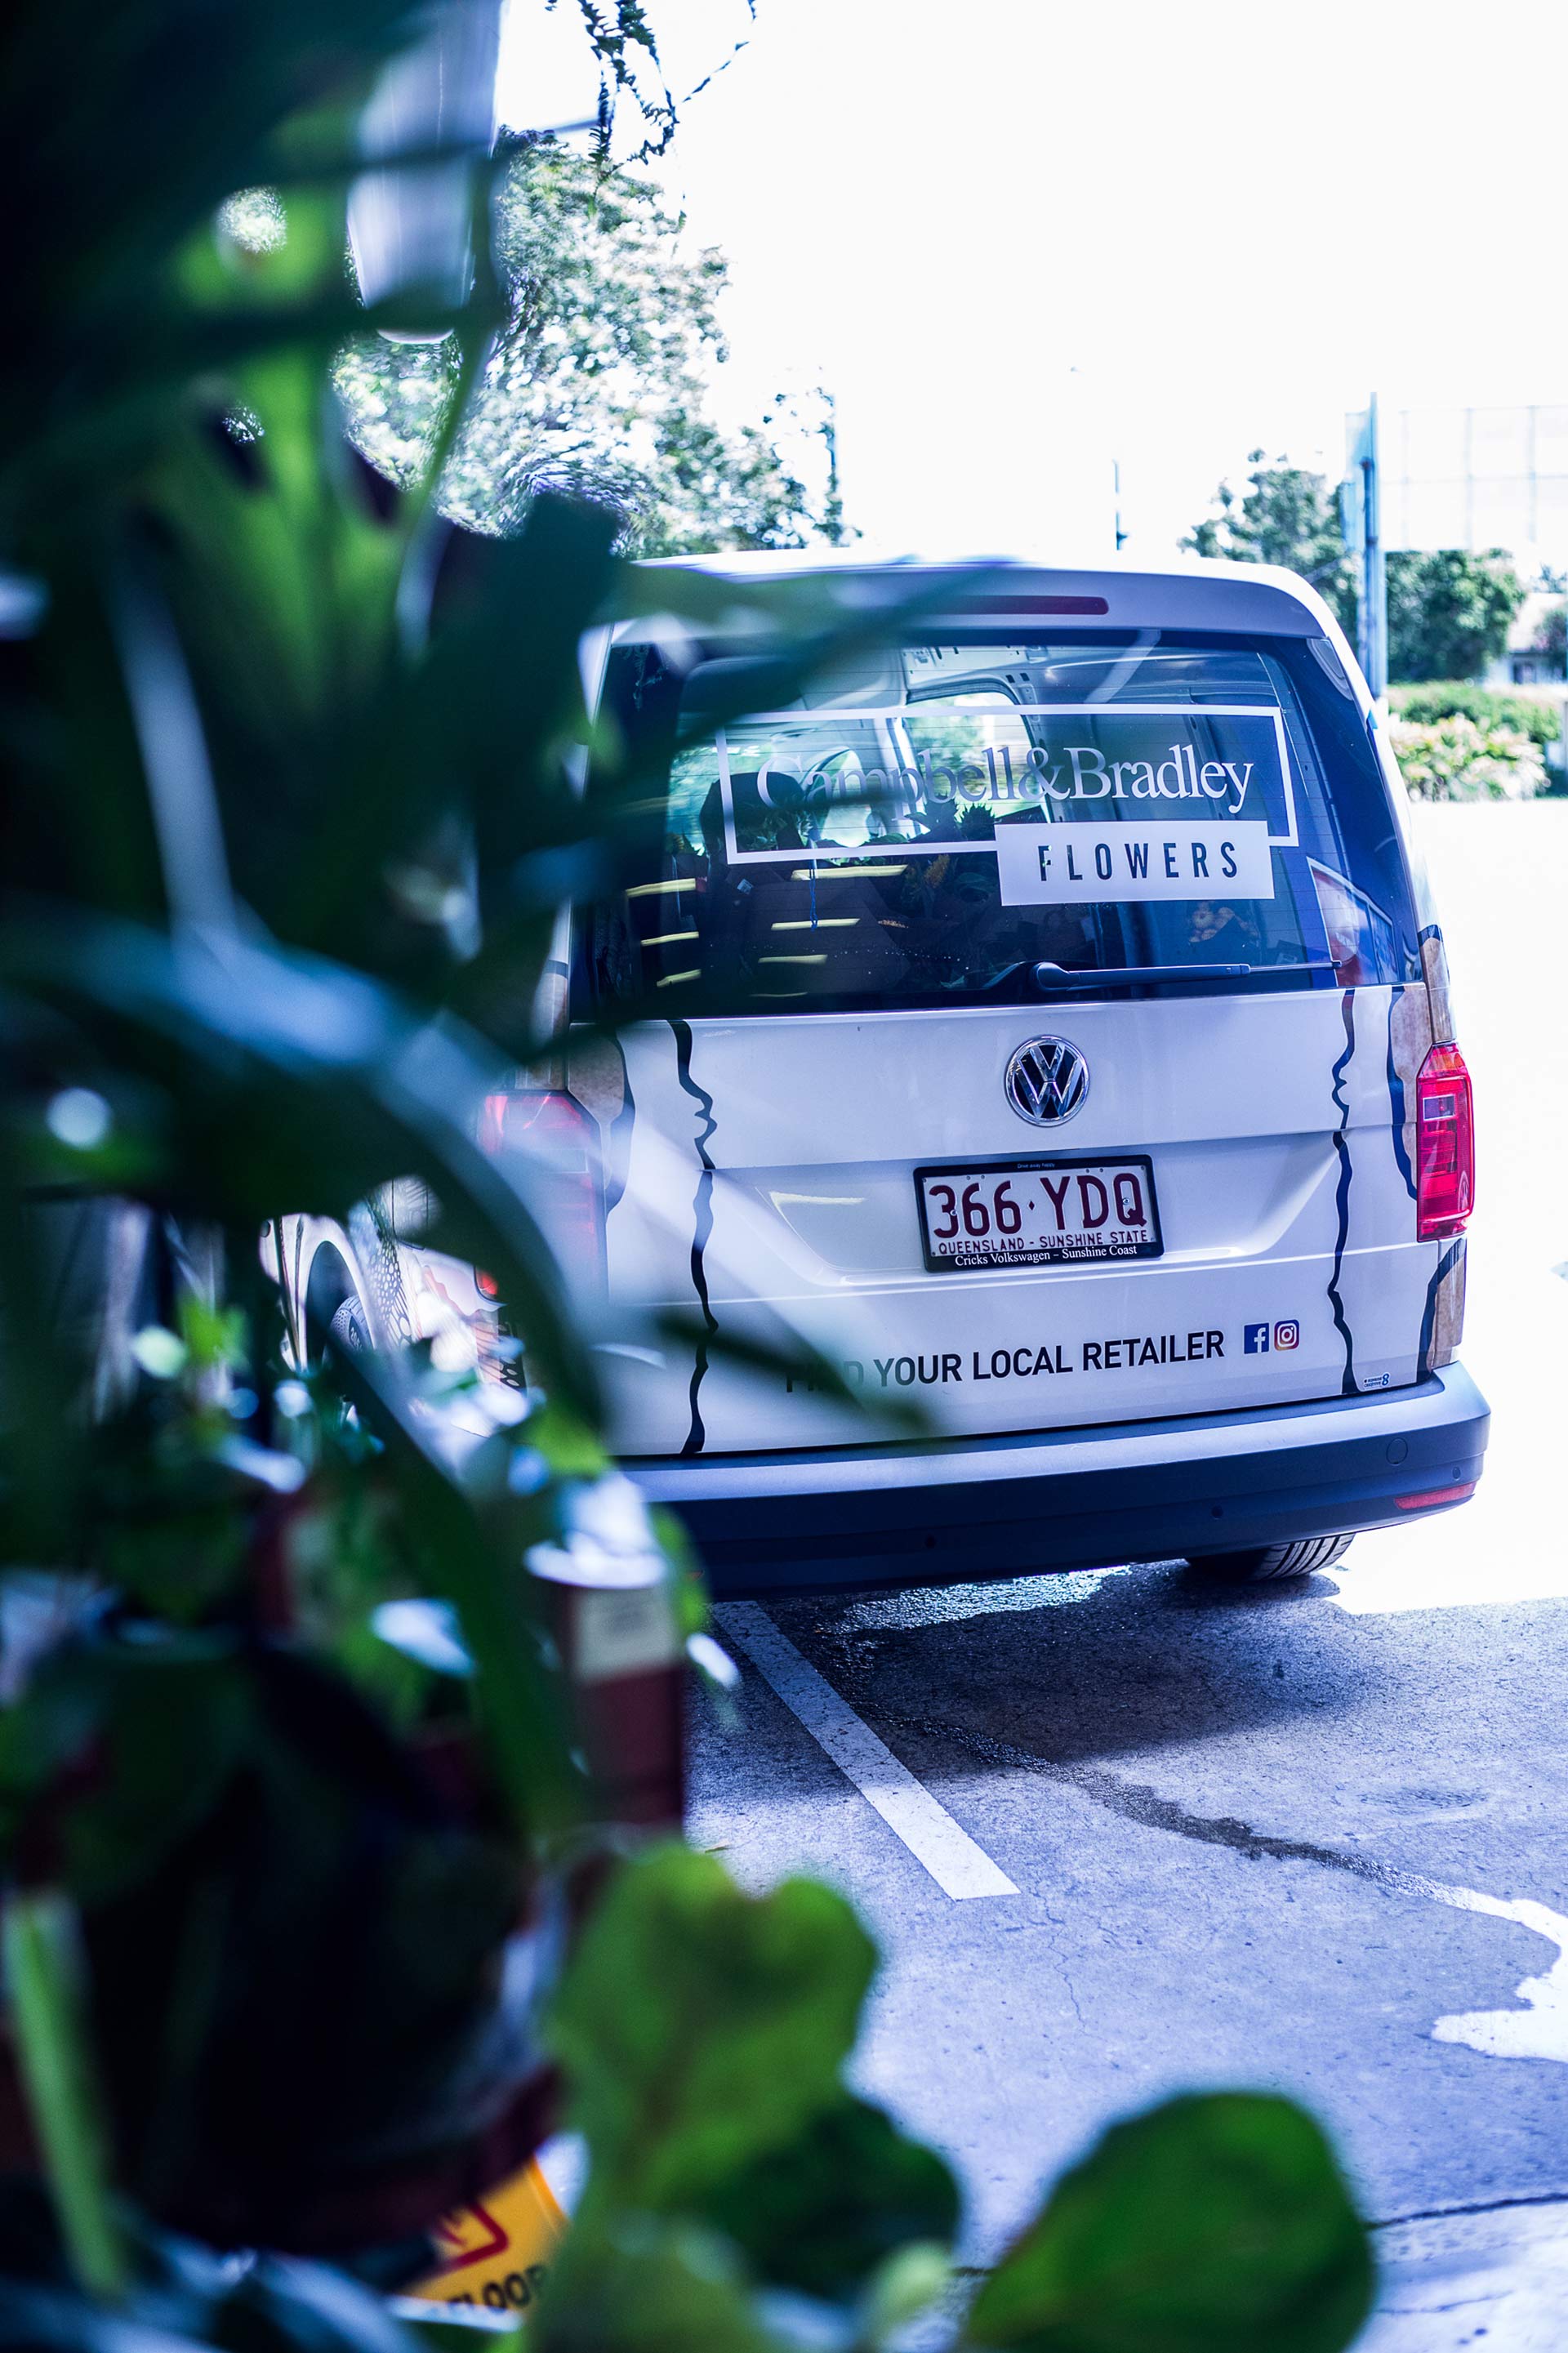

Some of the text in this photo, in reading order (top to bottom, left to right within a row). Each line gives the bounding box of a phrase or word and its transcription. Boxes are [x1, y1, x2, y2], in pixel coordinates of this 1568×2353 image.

[1037, 841, 1238, 882] FLOWERS
[938, 1237, 1025, 1255] QUEENSLAND
[1039, 1232, 1103, 1248] SUNSHINE
[1110, 1229, 1149, 1243] STATE
[955, 1254, 988, 1267] Cricks
[990, 1251, 1051, 1263] Volkswagen
[1061, 1246, 1107, 1259] Sunshine
[1108, 1245, 1138, 1256] Coast
[872, 1353, 963, 1388] YOUR
[973, 1345, 1074, 1380] LOCAL
[1082, 1330, 1225, 1371] RETAILER
